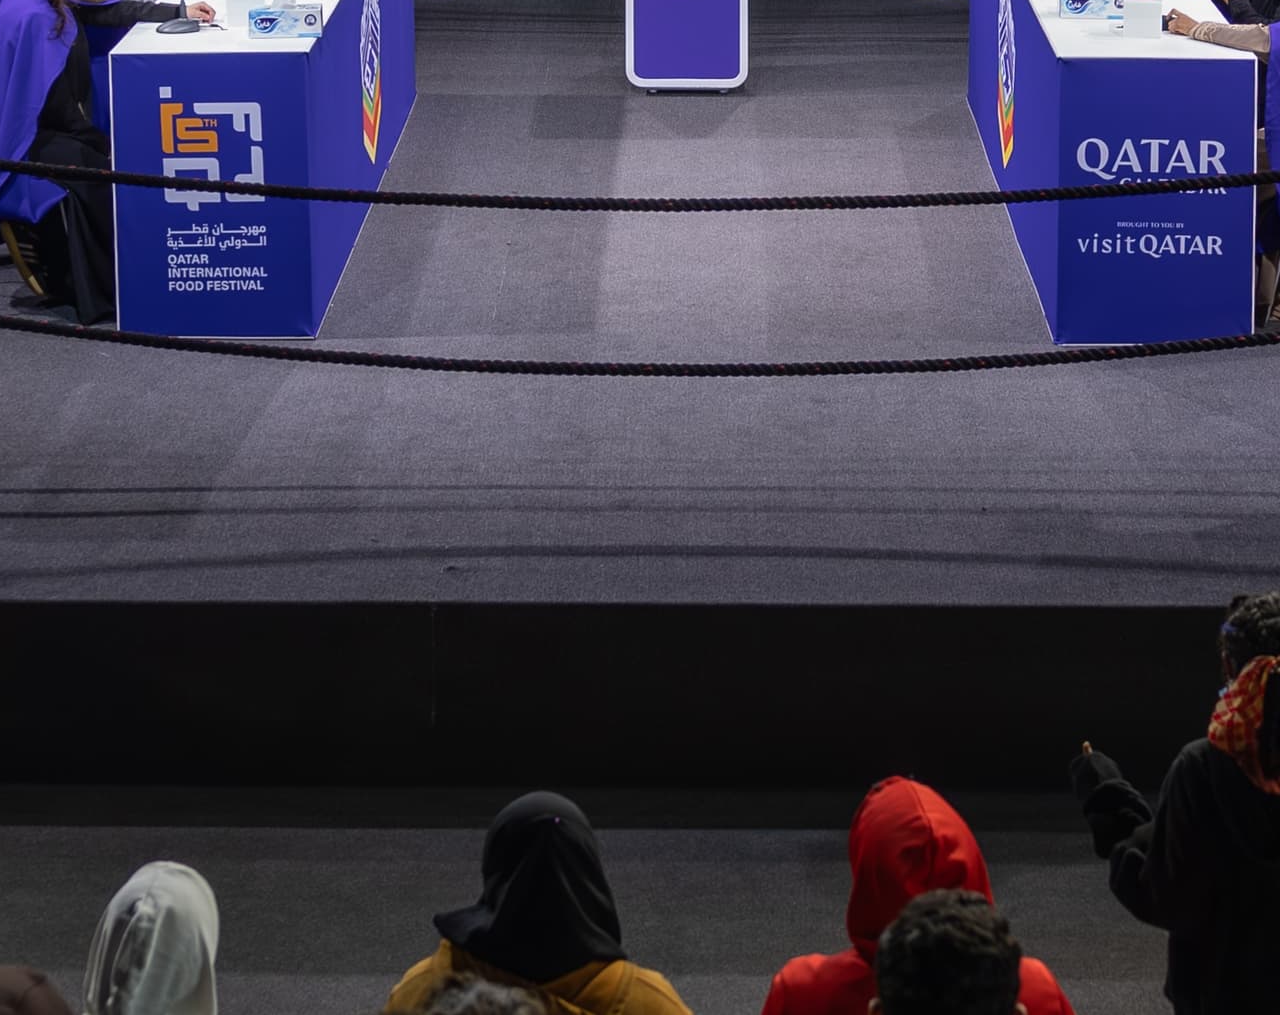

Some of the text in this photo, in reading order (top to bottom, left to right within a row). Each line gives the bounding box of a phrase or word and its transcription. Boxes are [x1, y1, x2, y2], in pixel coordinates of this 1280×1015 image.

[1076, 137, 1228, 181] QATAR
[166, 222, 266, 237] مهرجان قطر
[166, 234, 267, 251] الدولي للأغذية
[168, 254, 209, 268] QATAR
[168, 266, 268, 278] INTERNATIONAL
[168, 280, 264, 292] FOOD FESTIVAL
